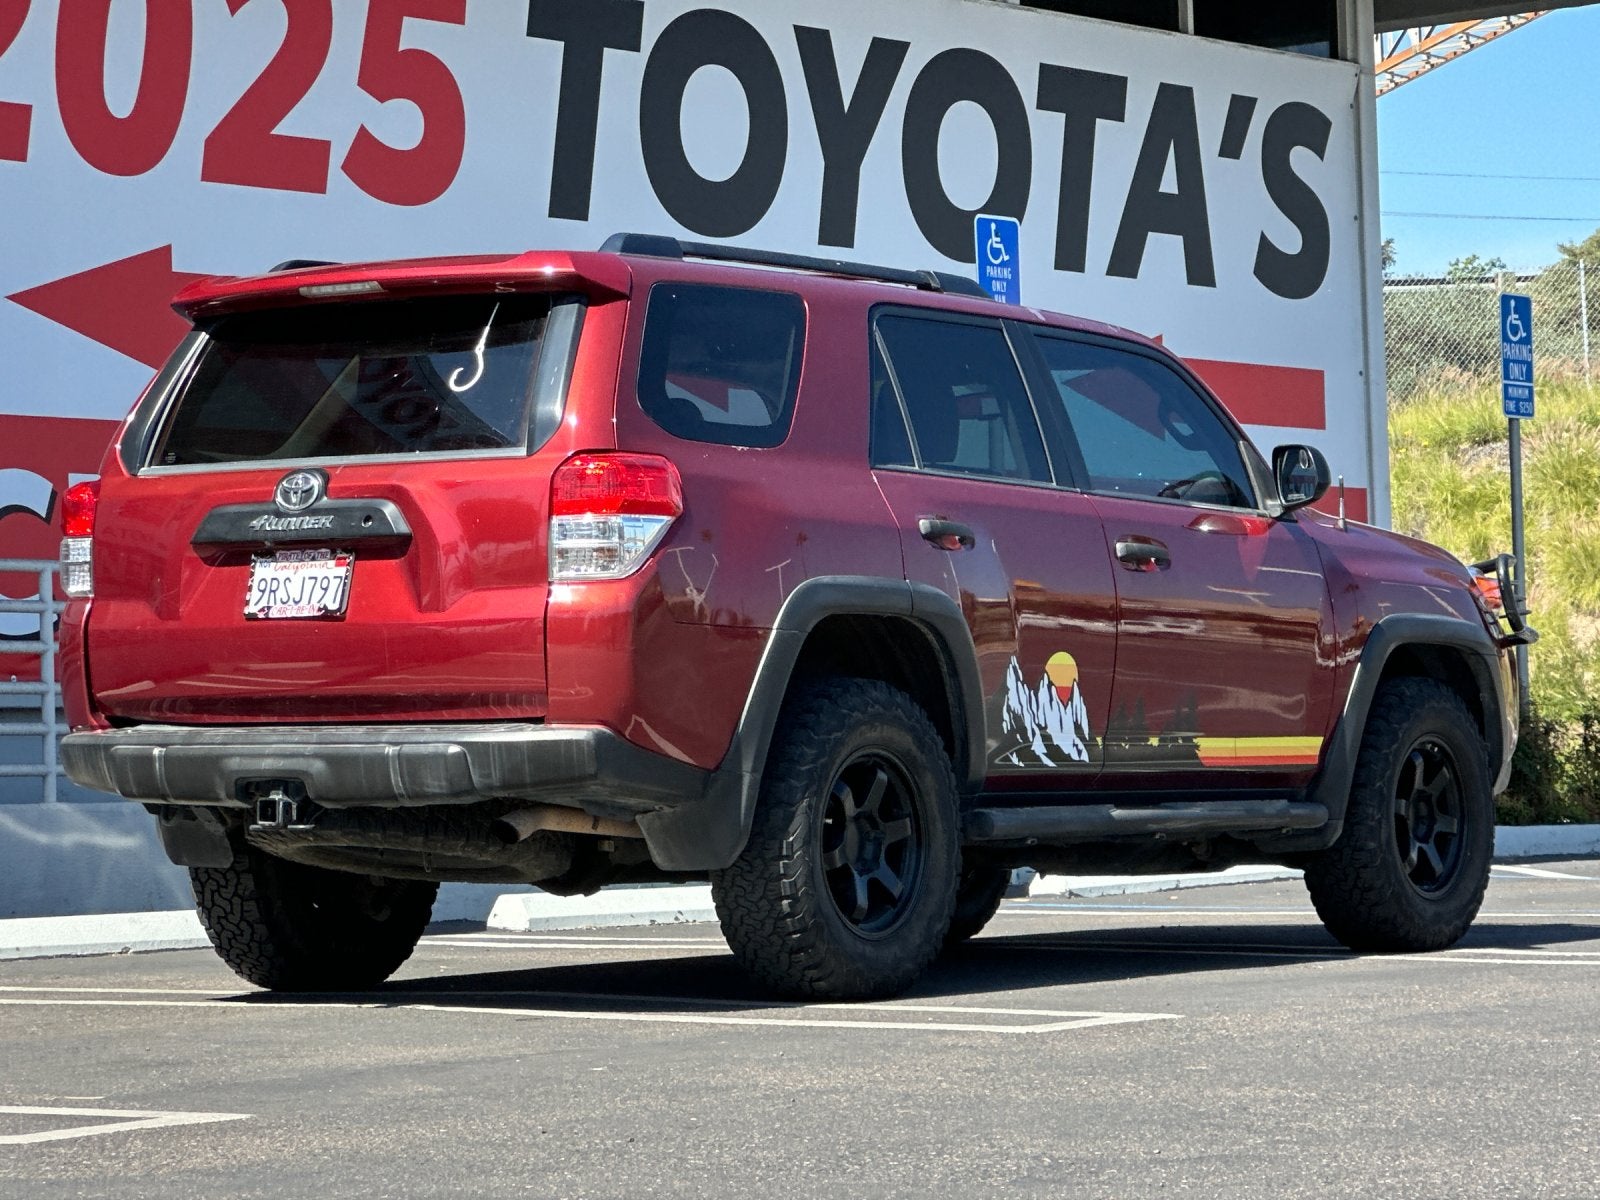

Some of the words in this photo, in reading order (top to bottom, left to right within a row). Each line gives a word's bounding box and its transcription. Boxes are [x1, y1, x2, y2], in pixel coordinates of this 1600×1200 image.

[0, 0, 466, 206] 025
[526, 0, 1332, 300] TOYOTA'S
[986, 265, 1012, 279] PARKING
[991, 280, 1007, 292] ONLY
[1503, 342, 1532, 361] PARKING
[1509, 362, 1527, 380] ONLY
[1508, 386, 1529, 399] MINIMUM
[1505, 400, 1516, 412] FINE
[1519, 401, 1533, 414] $250
[253, 575, 344, 606] 9RSJ797
